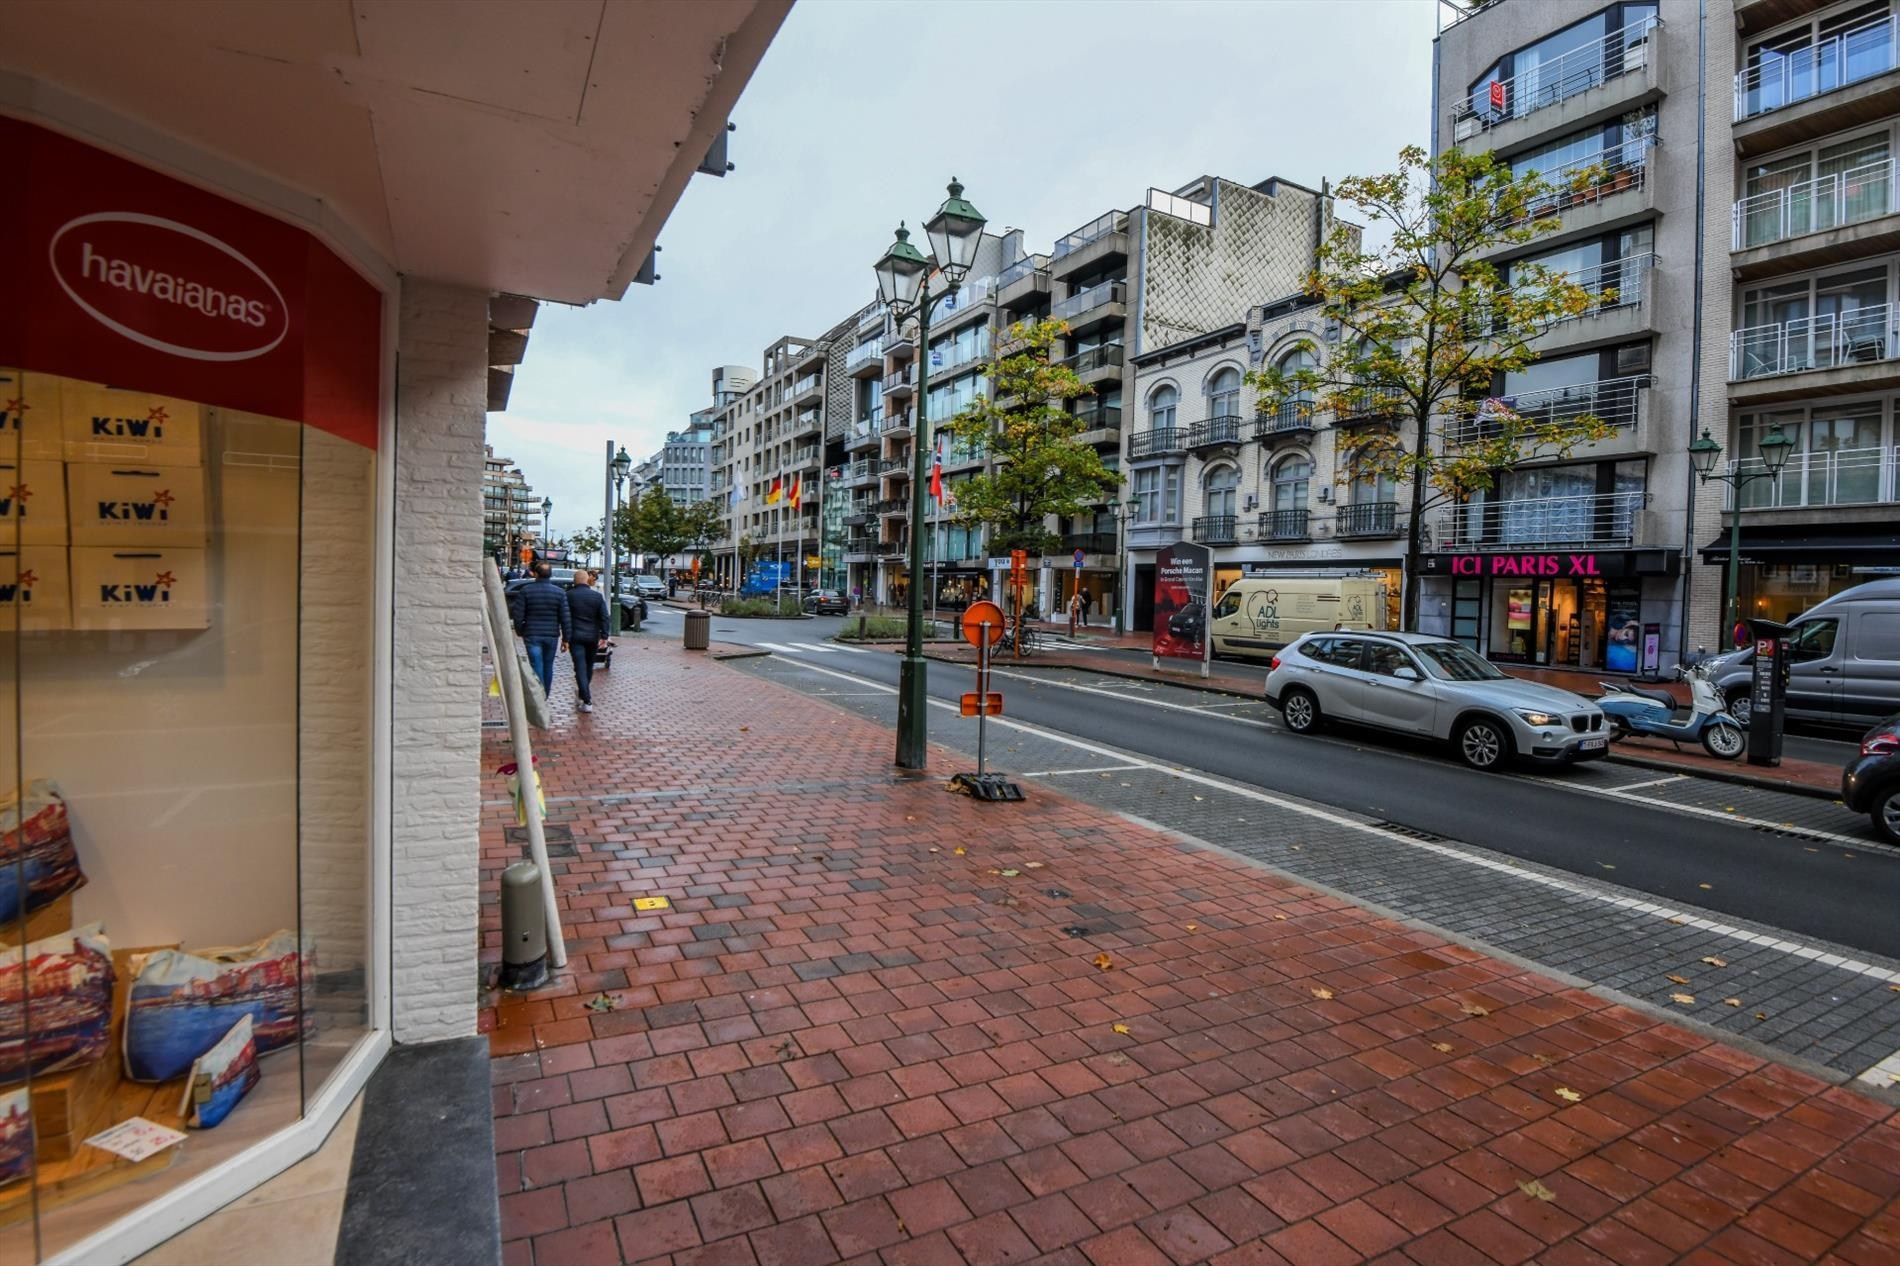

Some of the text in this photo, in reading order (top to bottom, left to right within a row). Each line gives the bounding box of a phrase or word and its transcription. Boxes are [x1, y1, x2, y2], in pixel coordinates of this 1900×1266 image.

[82, 242, 266, 327] havaianas
[1170, 557, 1182, 565] Win
[1452, 556, 1481, 575] ICI
[1491, 555, 1560, 575] PARIS
[1568, 554, 1600, 575] XL
[1183, 566, 1203, 574] Macan
[1258, 605, 1280, 618] ADL
